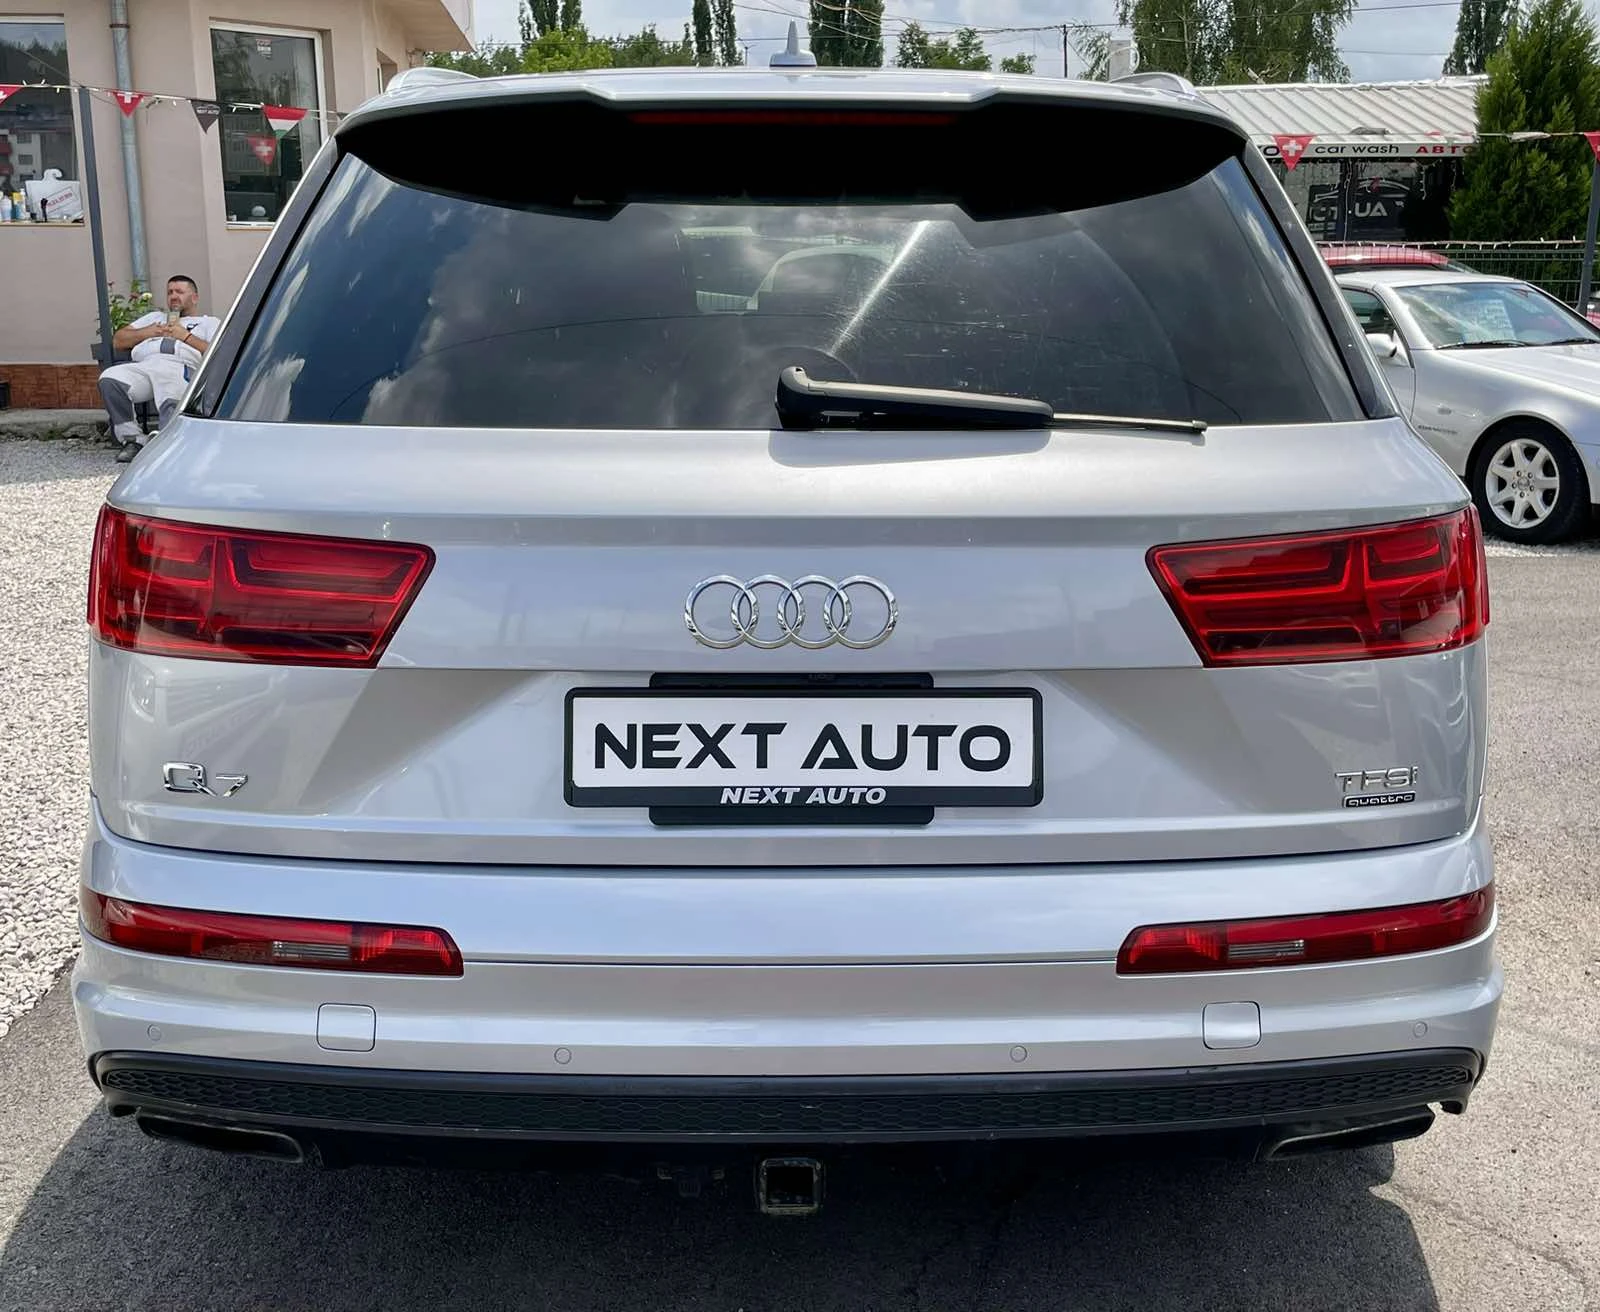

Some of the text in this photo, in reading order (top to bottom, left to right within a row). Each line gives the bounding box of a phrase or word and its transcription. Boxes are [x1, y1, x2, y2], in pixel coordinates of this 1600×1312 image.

[1314, 144, 1399, 154] car wash
[595, 722, 1011, 771] NEXT AUTO
[163, 761, 248, 797] Q7
[720, 787, 887, 804] NEXT AUTO
[1348, 794, 1413, 807] quattro
